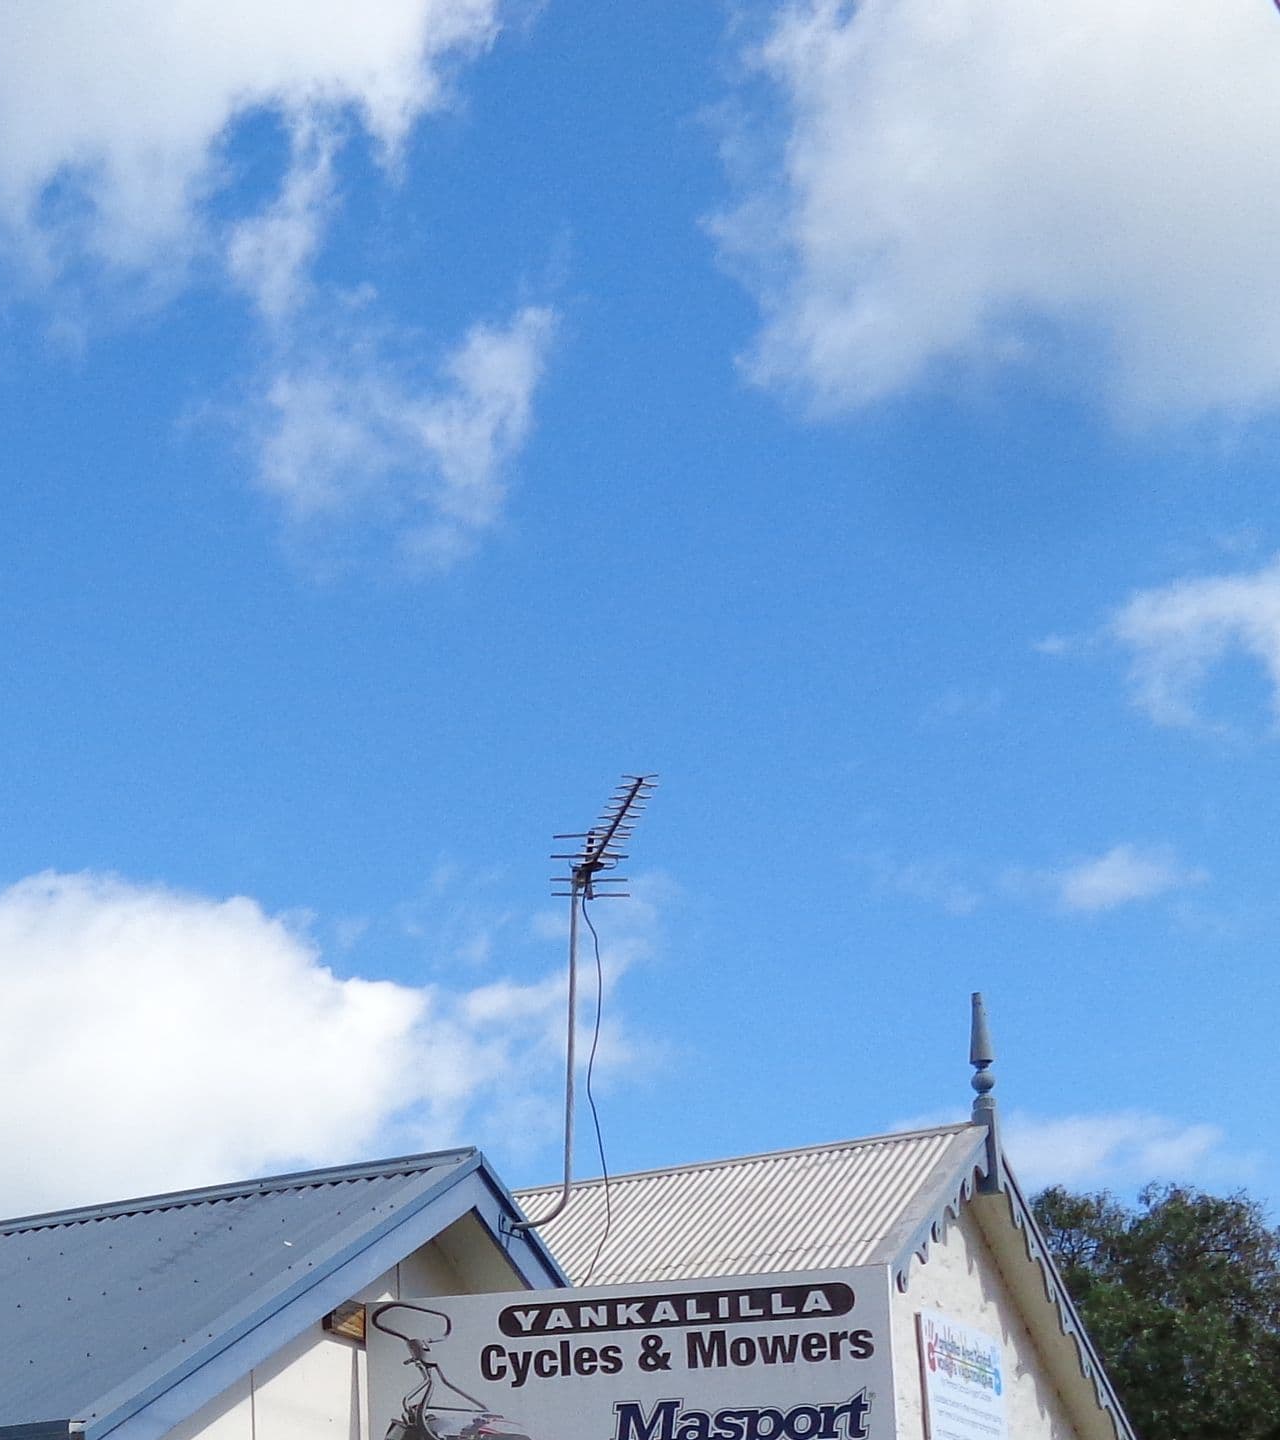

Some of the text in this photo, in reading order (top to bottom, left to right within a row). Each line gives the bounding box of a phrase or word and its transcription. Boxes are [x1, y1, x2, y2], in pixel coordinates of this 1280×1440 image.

[513, 1289, 833, 1332] YANKALILLA
[480, 1326, 875, 1388] Cycles & Mowers
